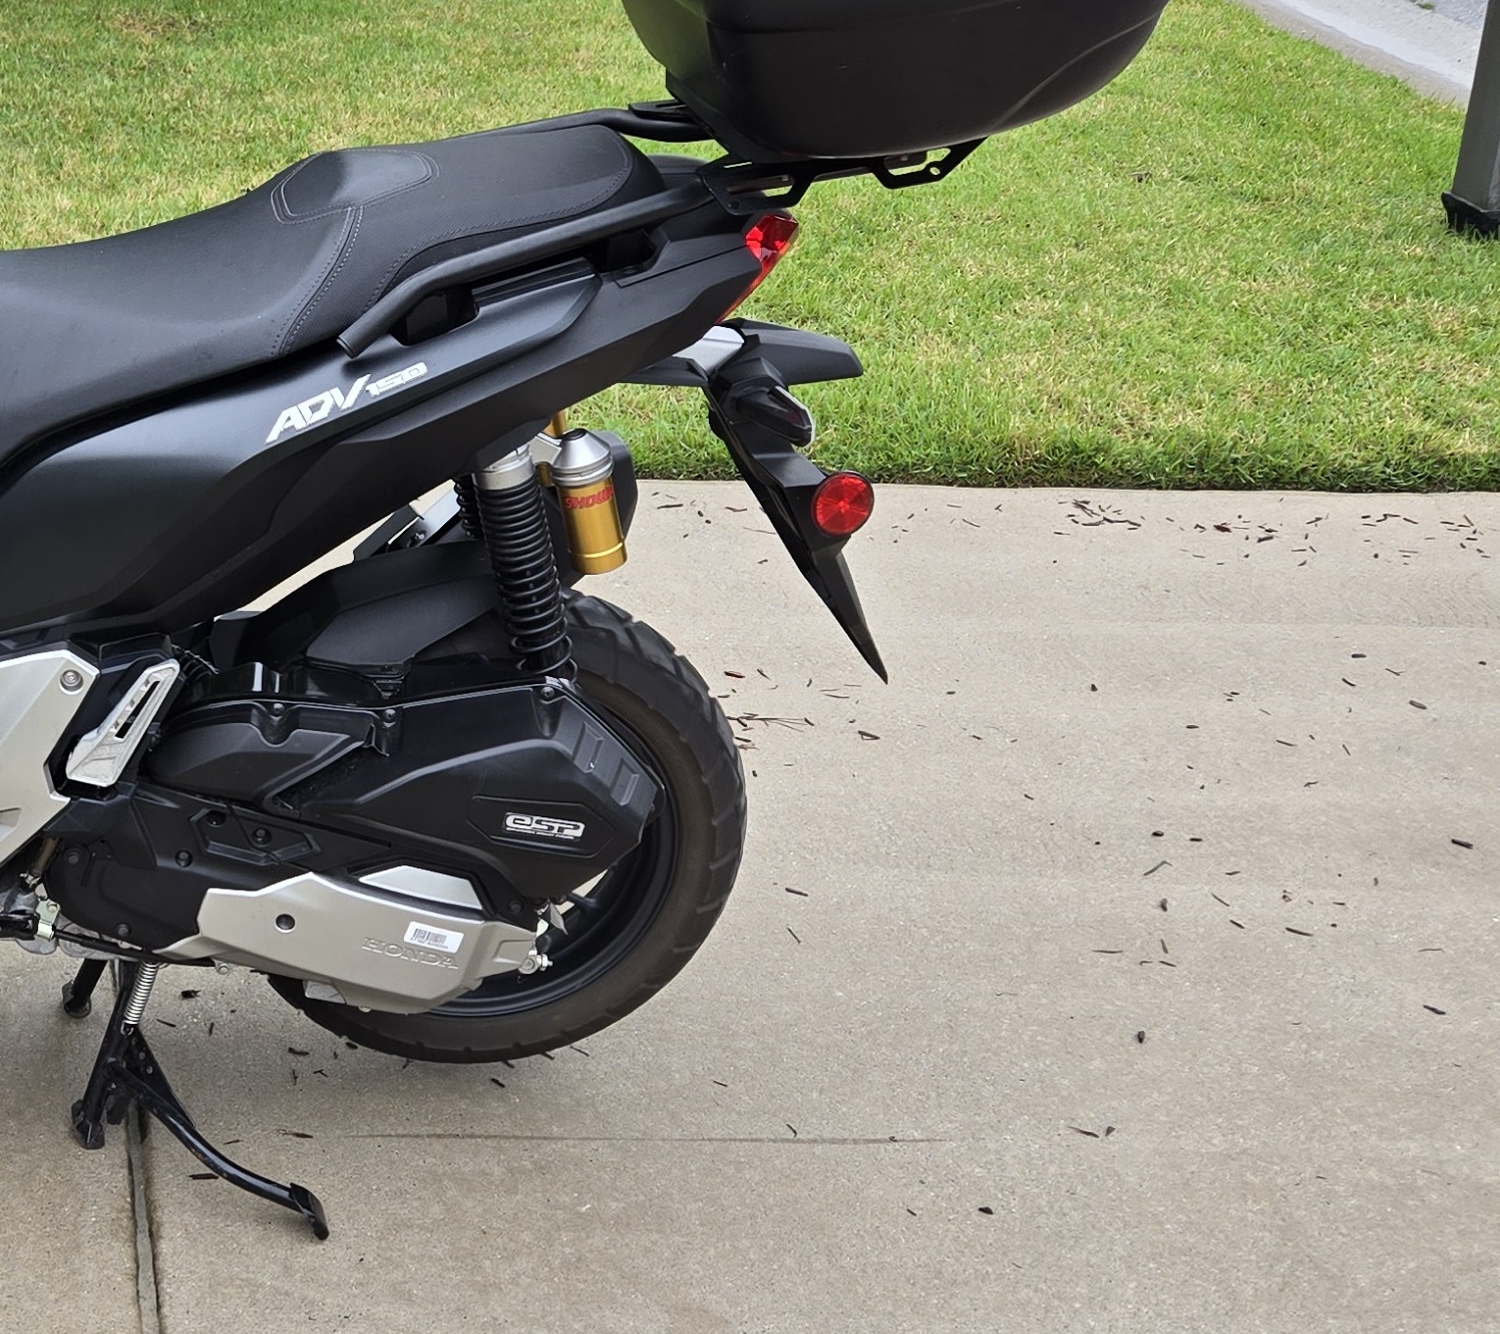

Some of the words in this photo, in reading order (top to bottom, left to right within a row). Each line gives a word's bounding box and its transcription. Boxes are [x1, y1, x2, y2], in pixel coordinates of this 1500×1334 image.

[264, 373, 372, 445] ADV
[365, 361, 429, 398] 150
[361, 936, 460, 970] HONDA
